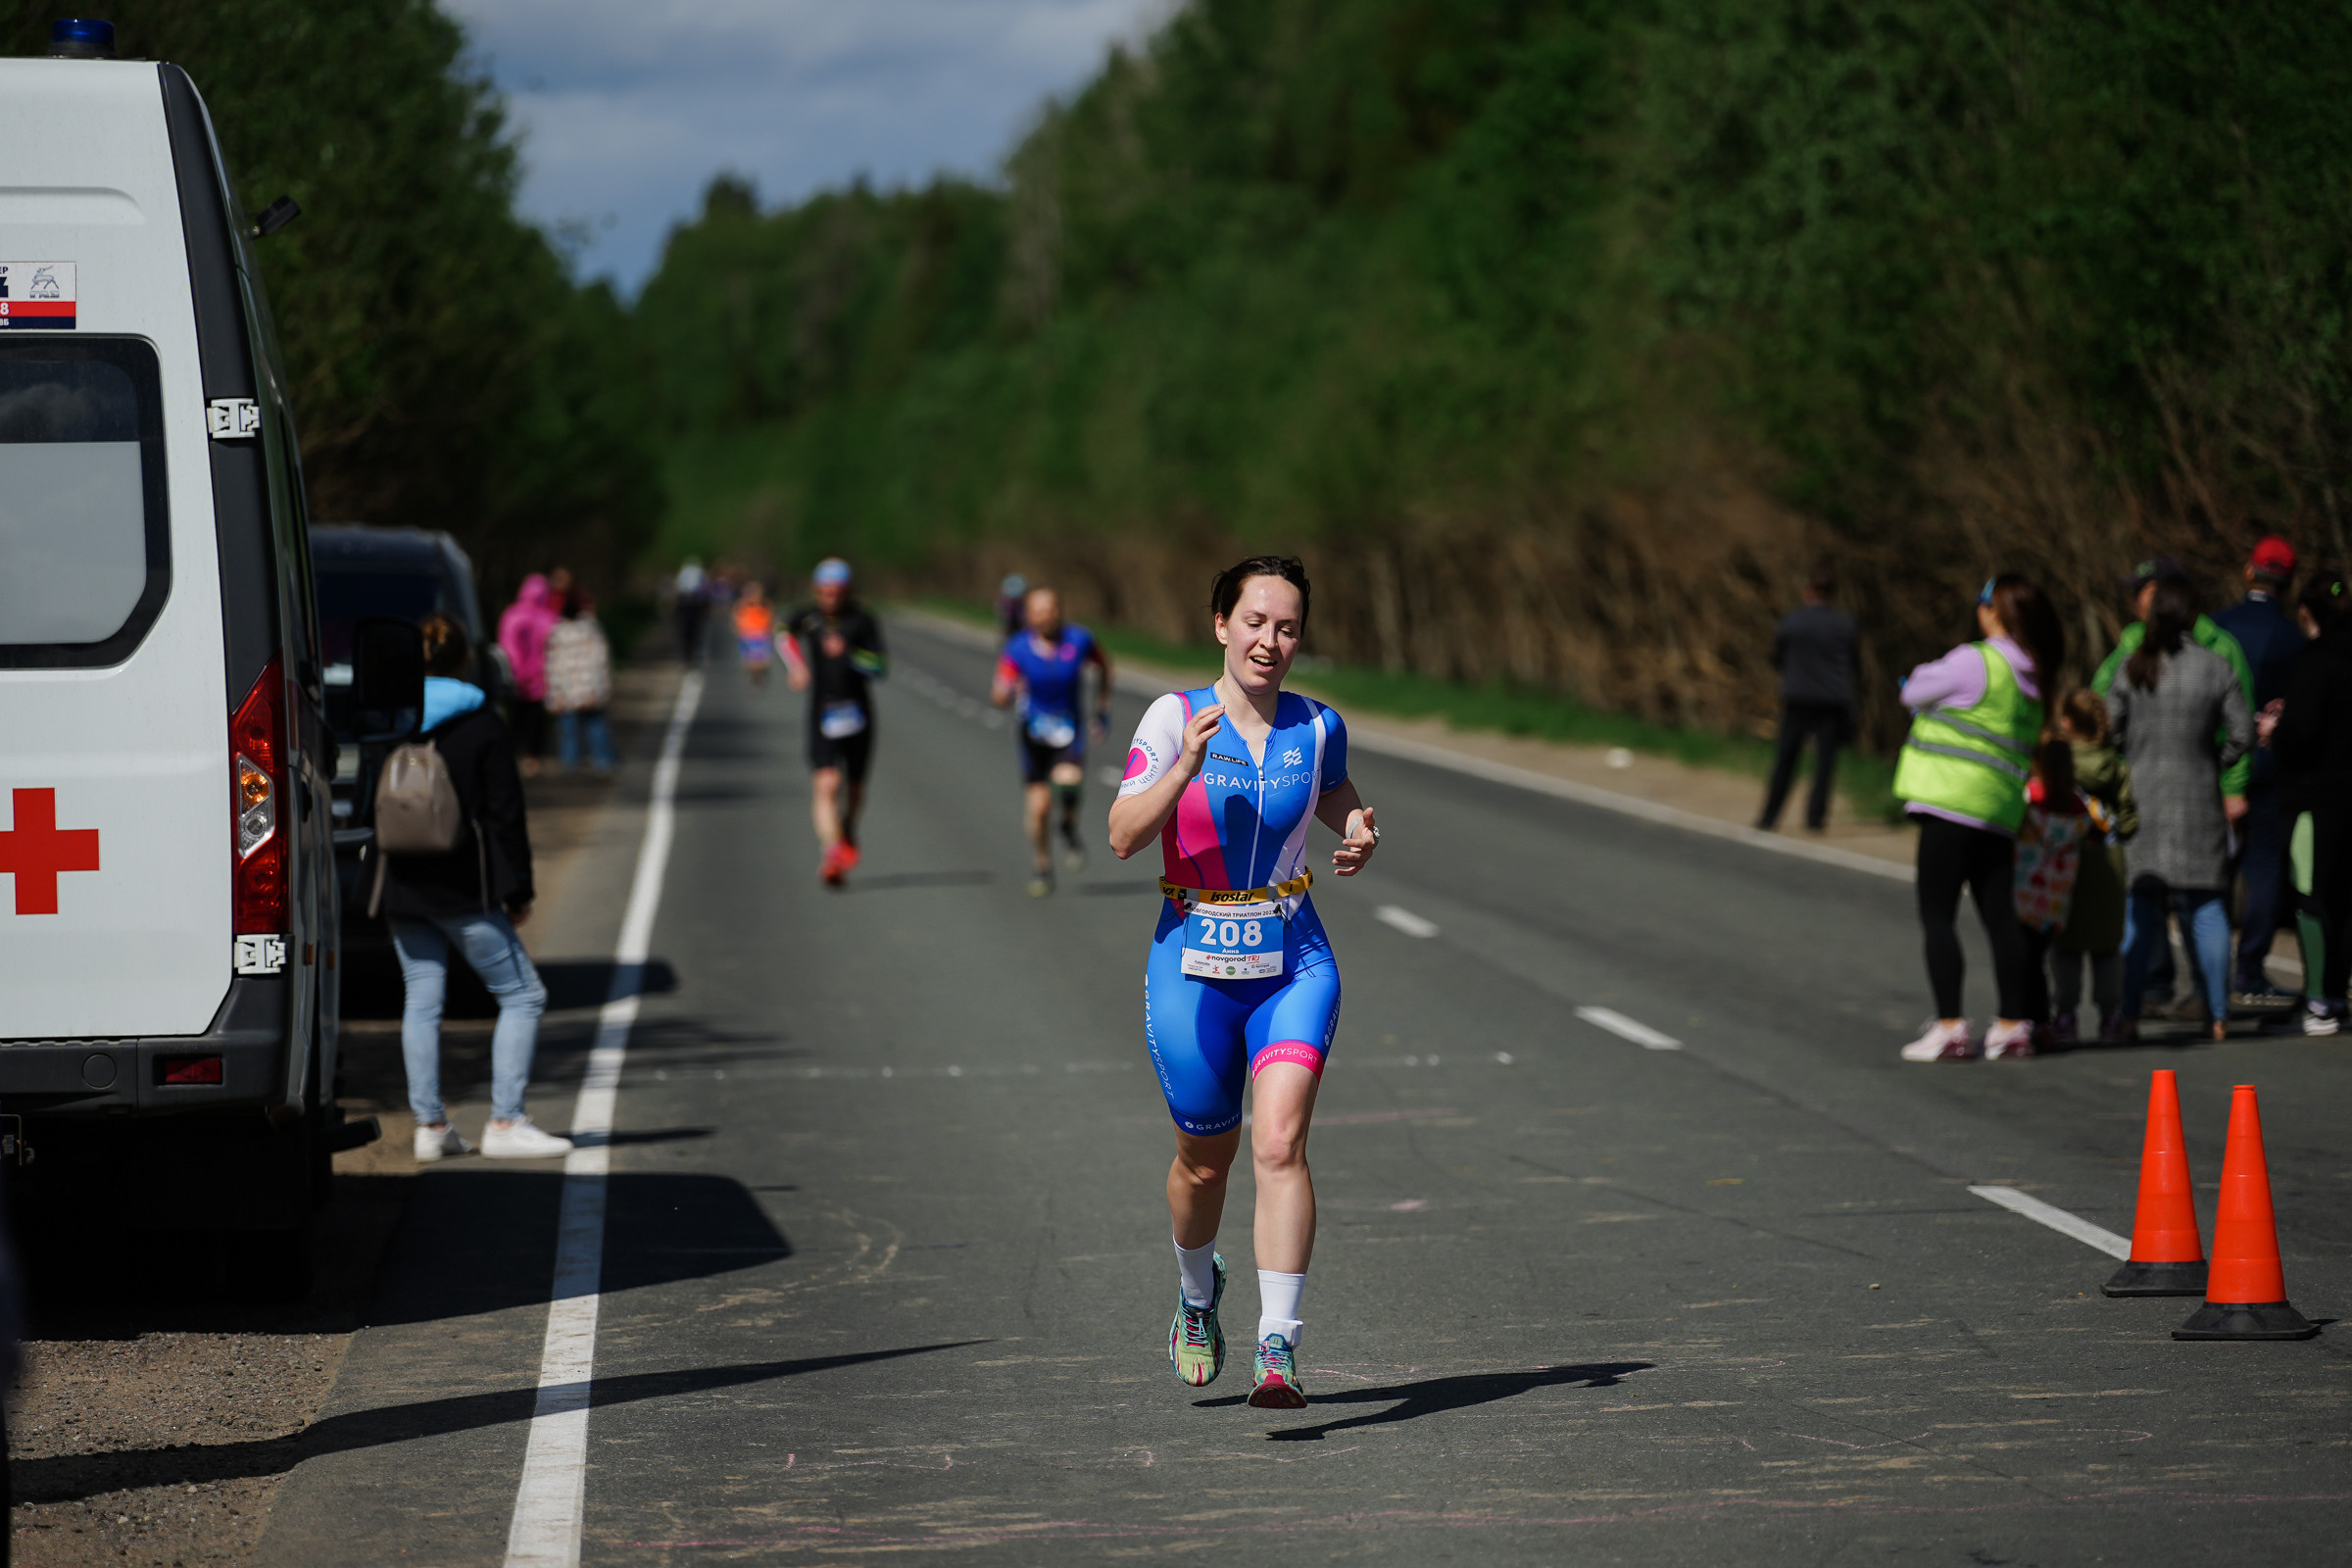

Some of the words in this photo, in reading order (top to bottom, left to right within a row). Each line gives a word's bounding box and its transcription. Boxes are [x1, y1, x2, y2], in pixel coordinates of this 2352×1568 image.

[1139, 764, 1158, 785] ЦЕНТР
[1200, 918, 1263, 948] 208
[1145, 990, 1174, 1100] GRAVITYSPORT
[1254, 1048, 1318, 1071] GRAVITYSPORT
